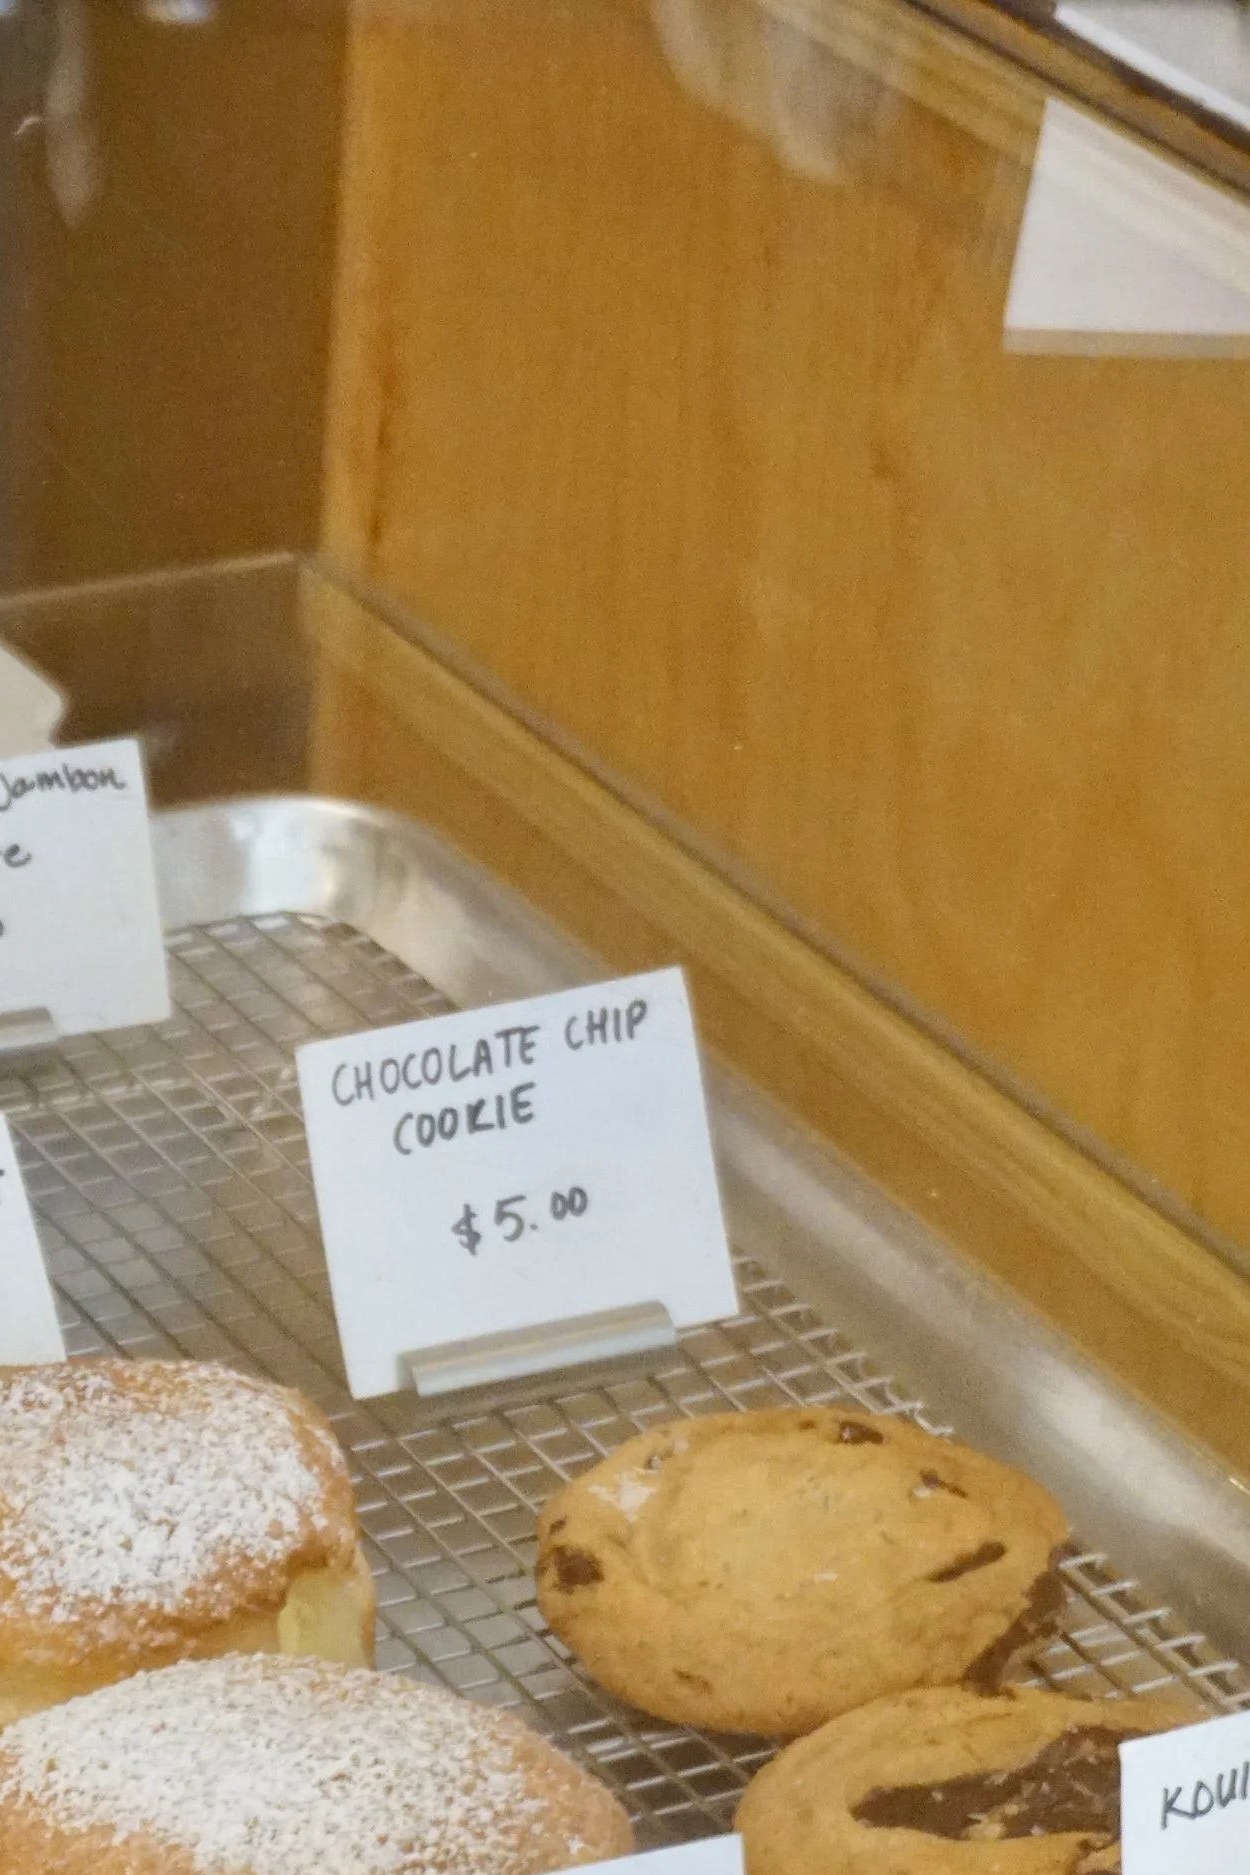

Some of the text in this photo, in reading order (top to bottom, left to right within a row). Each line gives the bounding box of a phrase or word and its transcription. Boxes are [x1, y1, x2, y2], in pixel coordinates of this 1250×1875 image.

[332, 999, 648, 1107] CHOCOLATE CHIP
[393, 1081, 536, 1156] COOKIE
